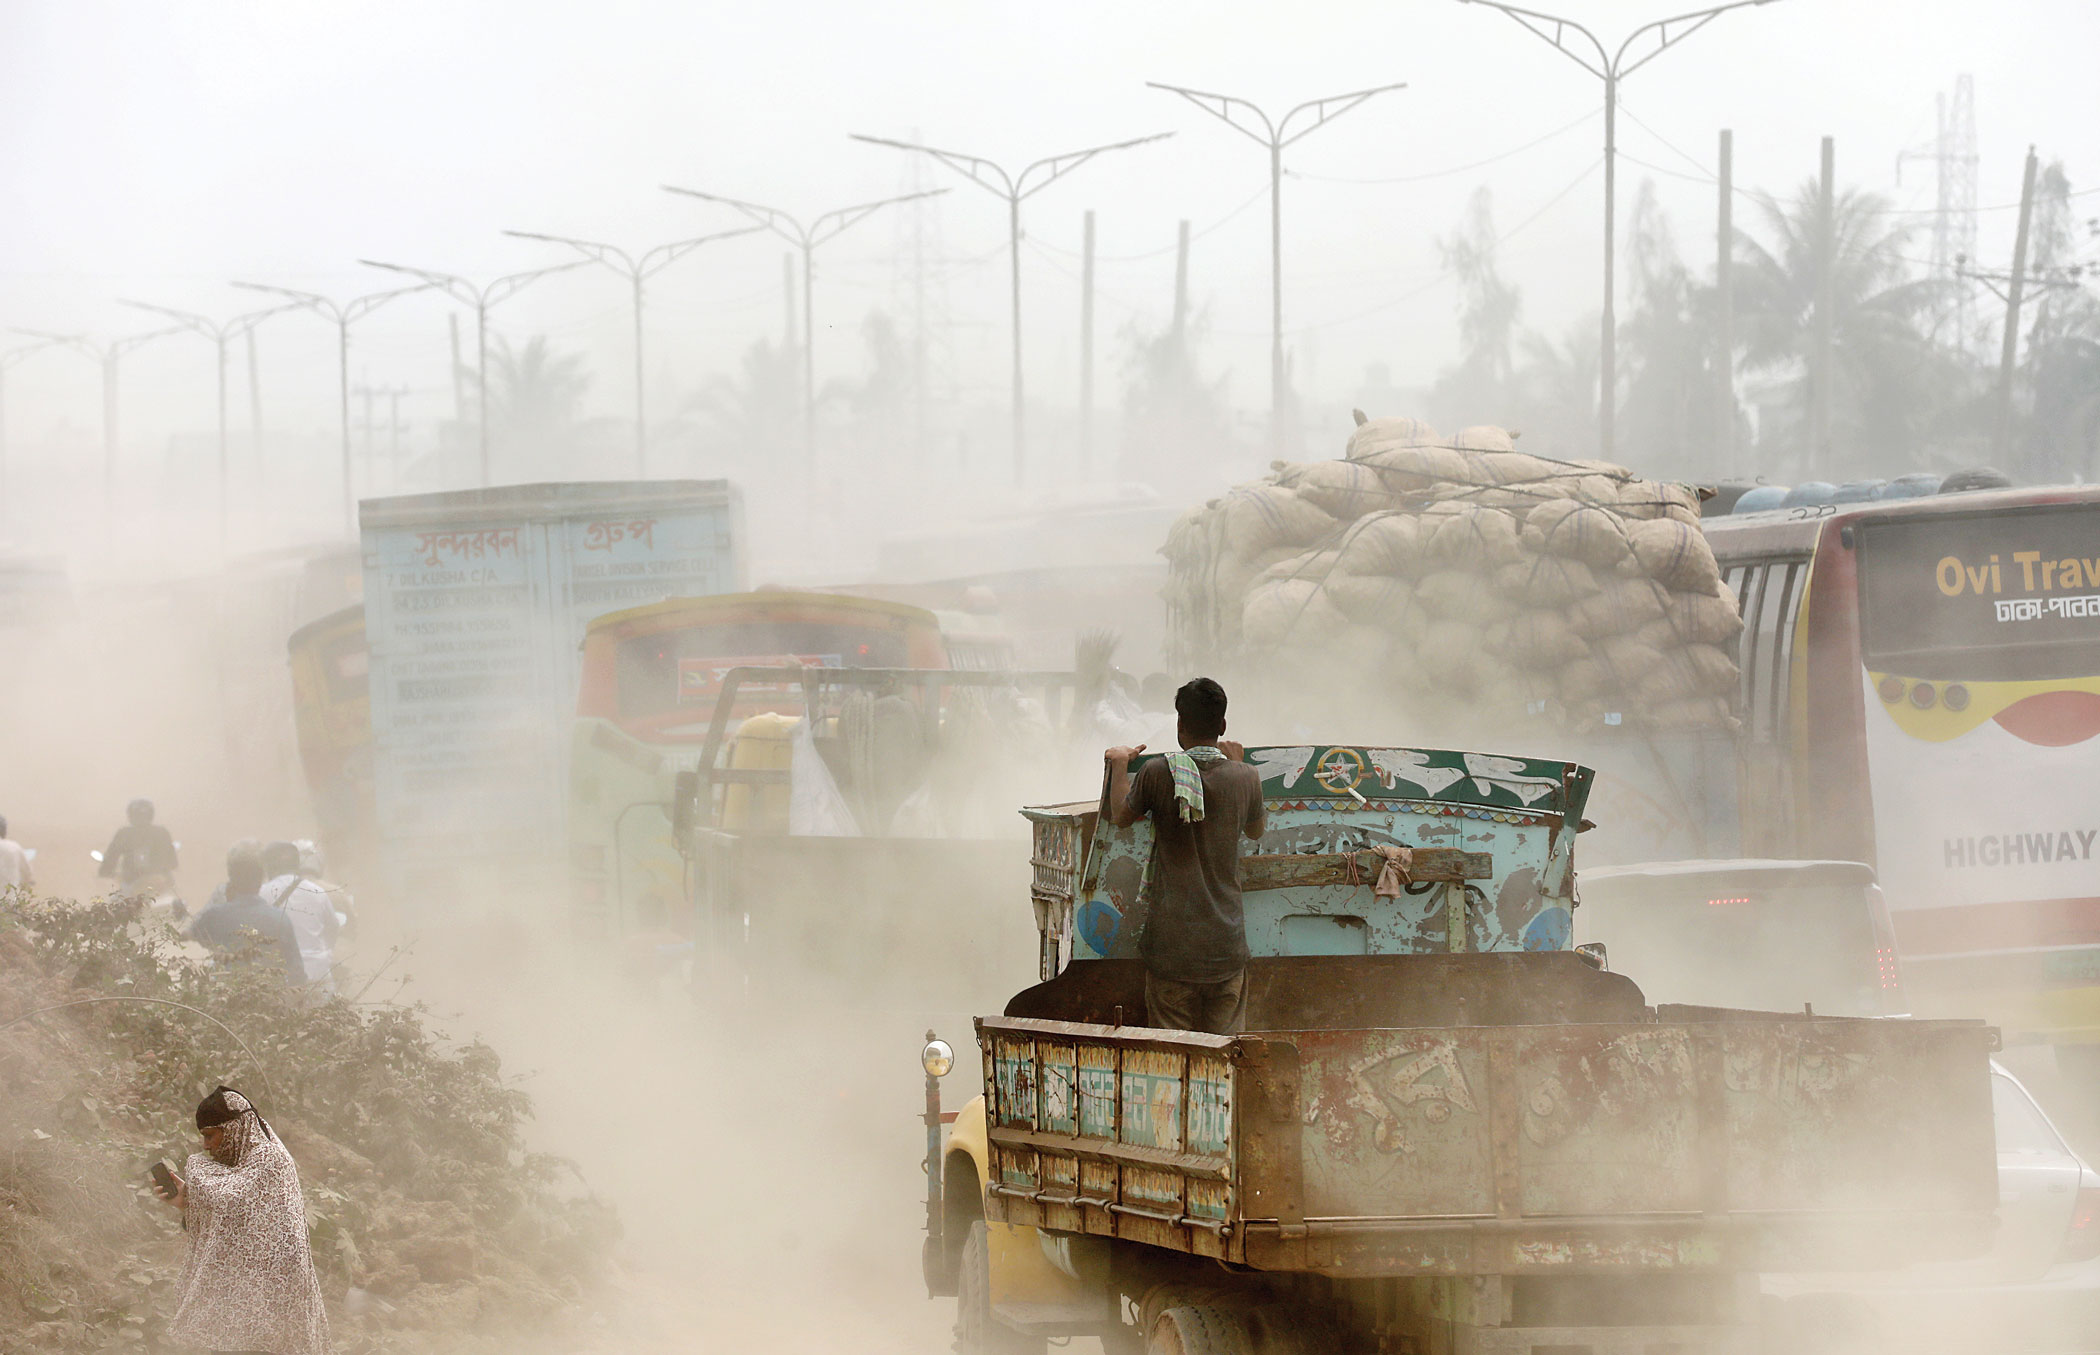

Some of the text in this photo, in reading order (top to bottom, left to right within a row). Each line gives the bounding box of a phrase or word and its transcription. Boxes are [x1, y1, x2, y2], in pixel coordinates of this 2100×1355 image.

[415, 519, 658, 568] সুন্দরবন গ্রুপ
[400, 570, 465, 587] DILKUSHA
[471, 567, 498, 587] C/A
[1936, 551, 2100, 597] Ovi Trav
[1943, 830, 2098, 868] HIGHWAY
